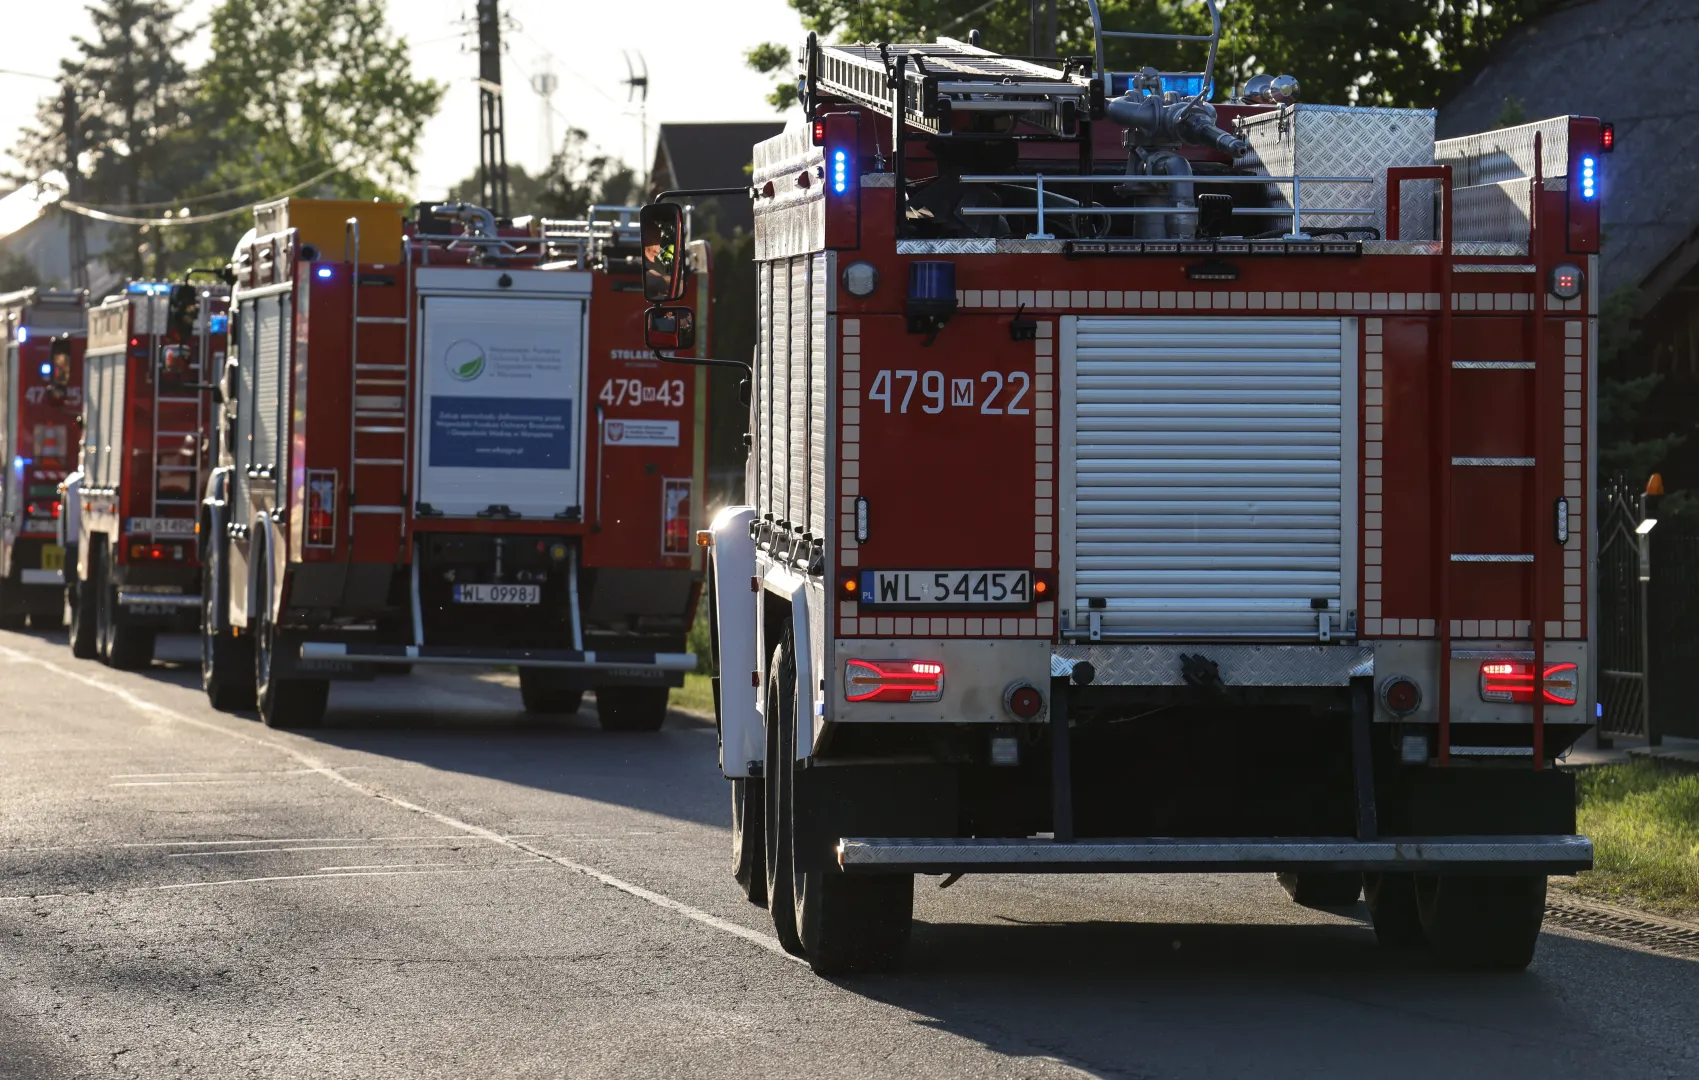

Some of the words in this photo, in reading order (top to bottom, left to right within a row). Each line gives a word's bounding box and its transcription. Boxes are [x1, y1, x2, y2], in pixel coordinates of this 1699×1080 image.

[610, 349, 675, 360] STOLARCYK
[463, 585, 485, 602] WL
[880, 573, 921, 601] WL
[934, 573, 1026, 601] 54454
